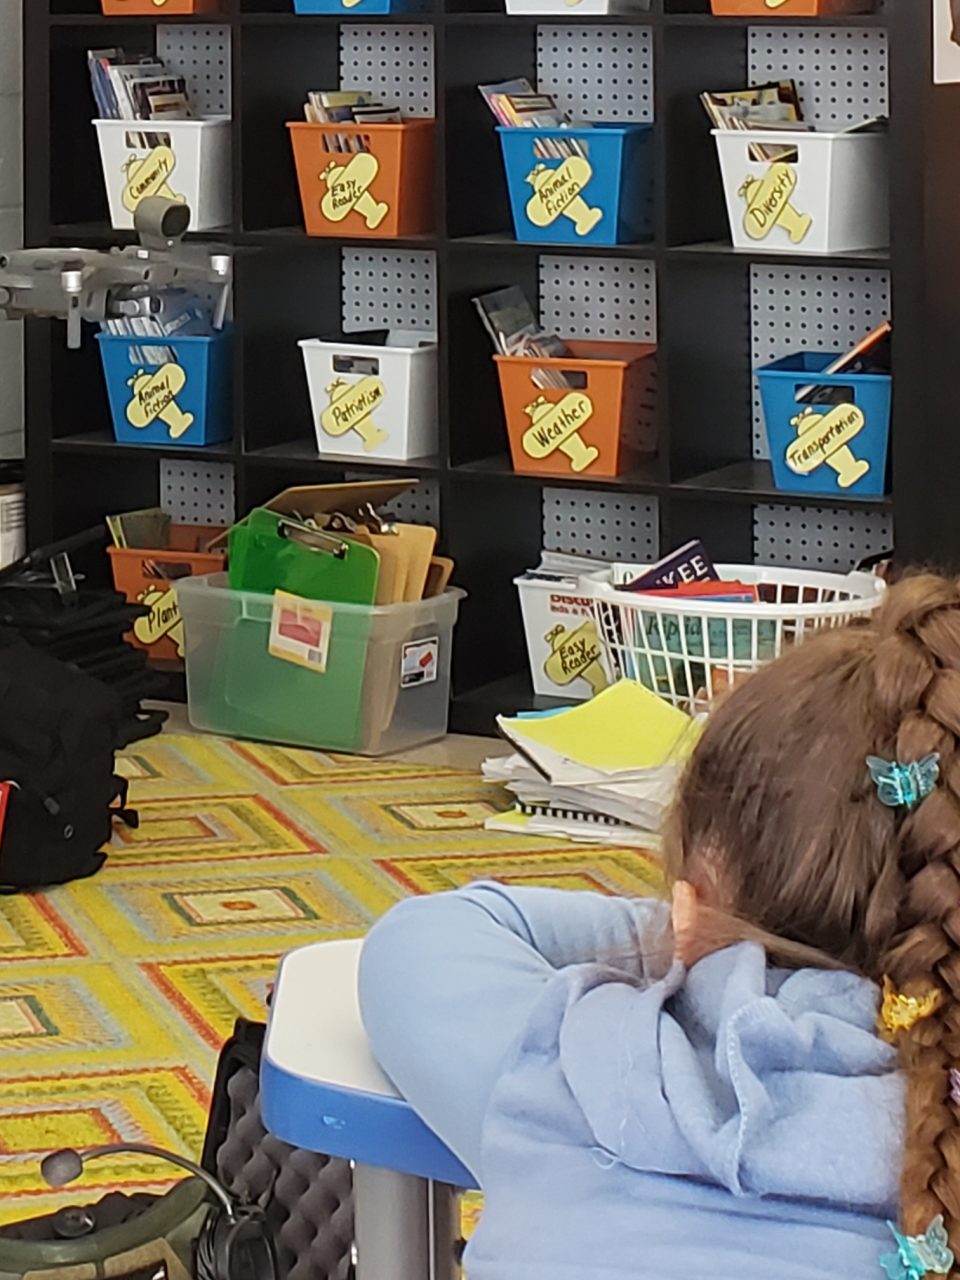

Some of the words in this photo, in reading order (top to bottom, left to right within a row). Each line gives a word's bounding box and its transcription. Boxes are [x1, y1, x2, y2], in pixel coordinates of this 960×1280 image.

[331, 179, 357, 198] Easy
[537, 166, 573, 204] Animal
[750, 168, 797, 229] Diversity
[139, 375, 171, 407] Animal
[331, 386, 384, 427] Patriotism
[531, 398, 588, 450] Weather
[787, 409, 860, 469] Transportation
[559, 637, 587, 661] Easy
